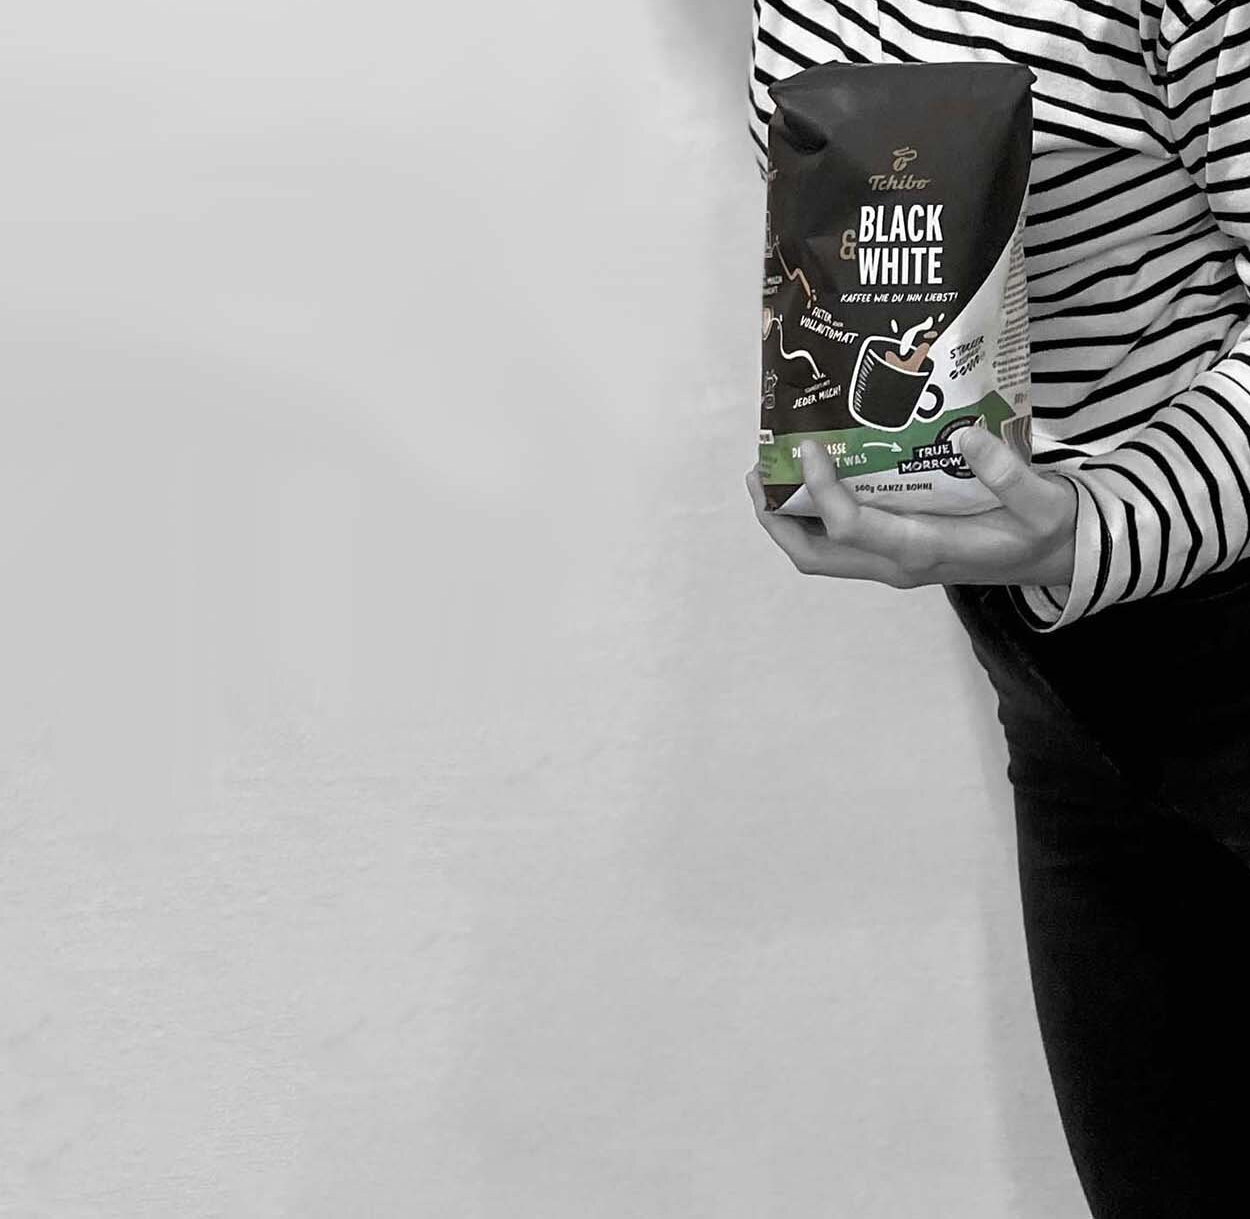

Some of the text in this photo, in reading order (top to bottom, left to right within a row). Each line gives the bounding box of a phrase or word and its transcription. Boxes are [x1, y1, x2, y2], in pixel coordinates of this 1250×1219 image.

[868, 174, 931, 191] Tchibo
[858, 204, 943, 242] BLACK
[840, 229, 856, 260] &
[858, 247, 943, 285] WHITE
[840, 292, 959, 303] KAFFEE WIE DU IHN LIEBST!
[800, 315, 859, 344] VOLLAUTOMAT
[793, 394, 817, 409] JEDER
[824, 443, 847, 455] ASSE
[917, 444, 950, 458] TRUE
[844, 453, 867, 466] WAS
[902, 456, 962, 472] MORROW
[877, 484, 903, 492] GANZE
[907, 483, 932, 491] BOHNE
